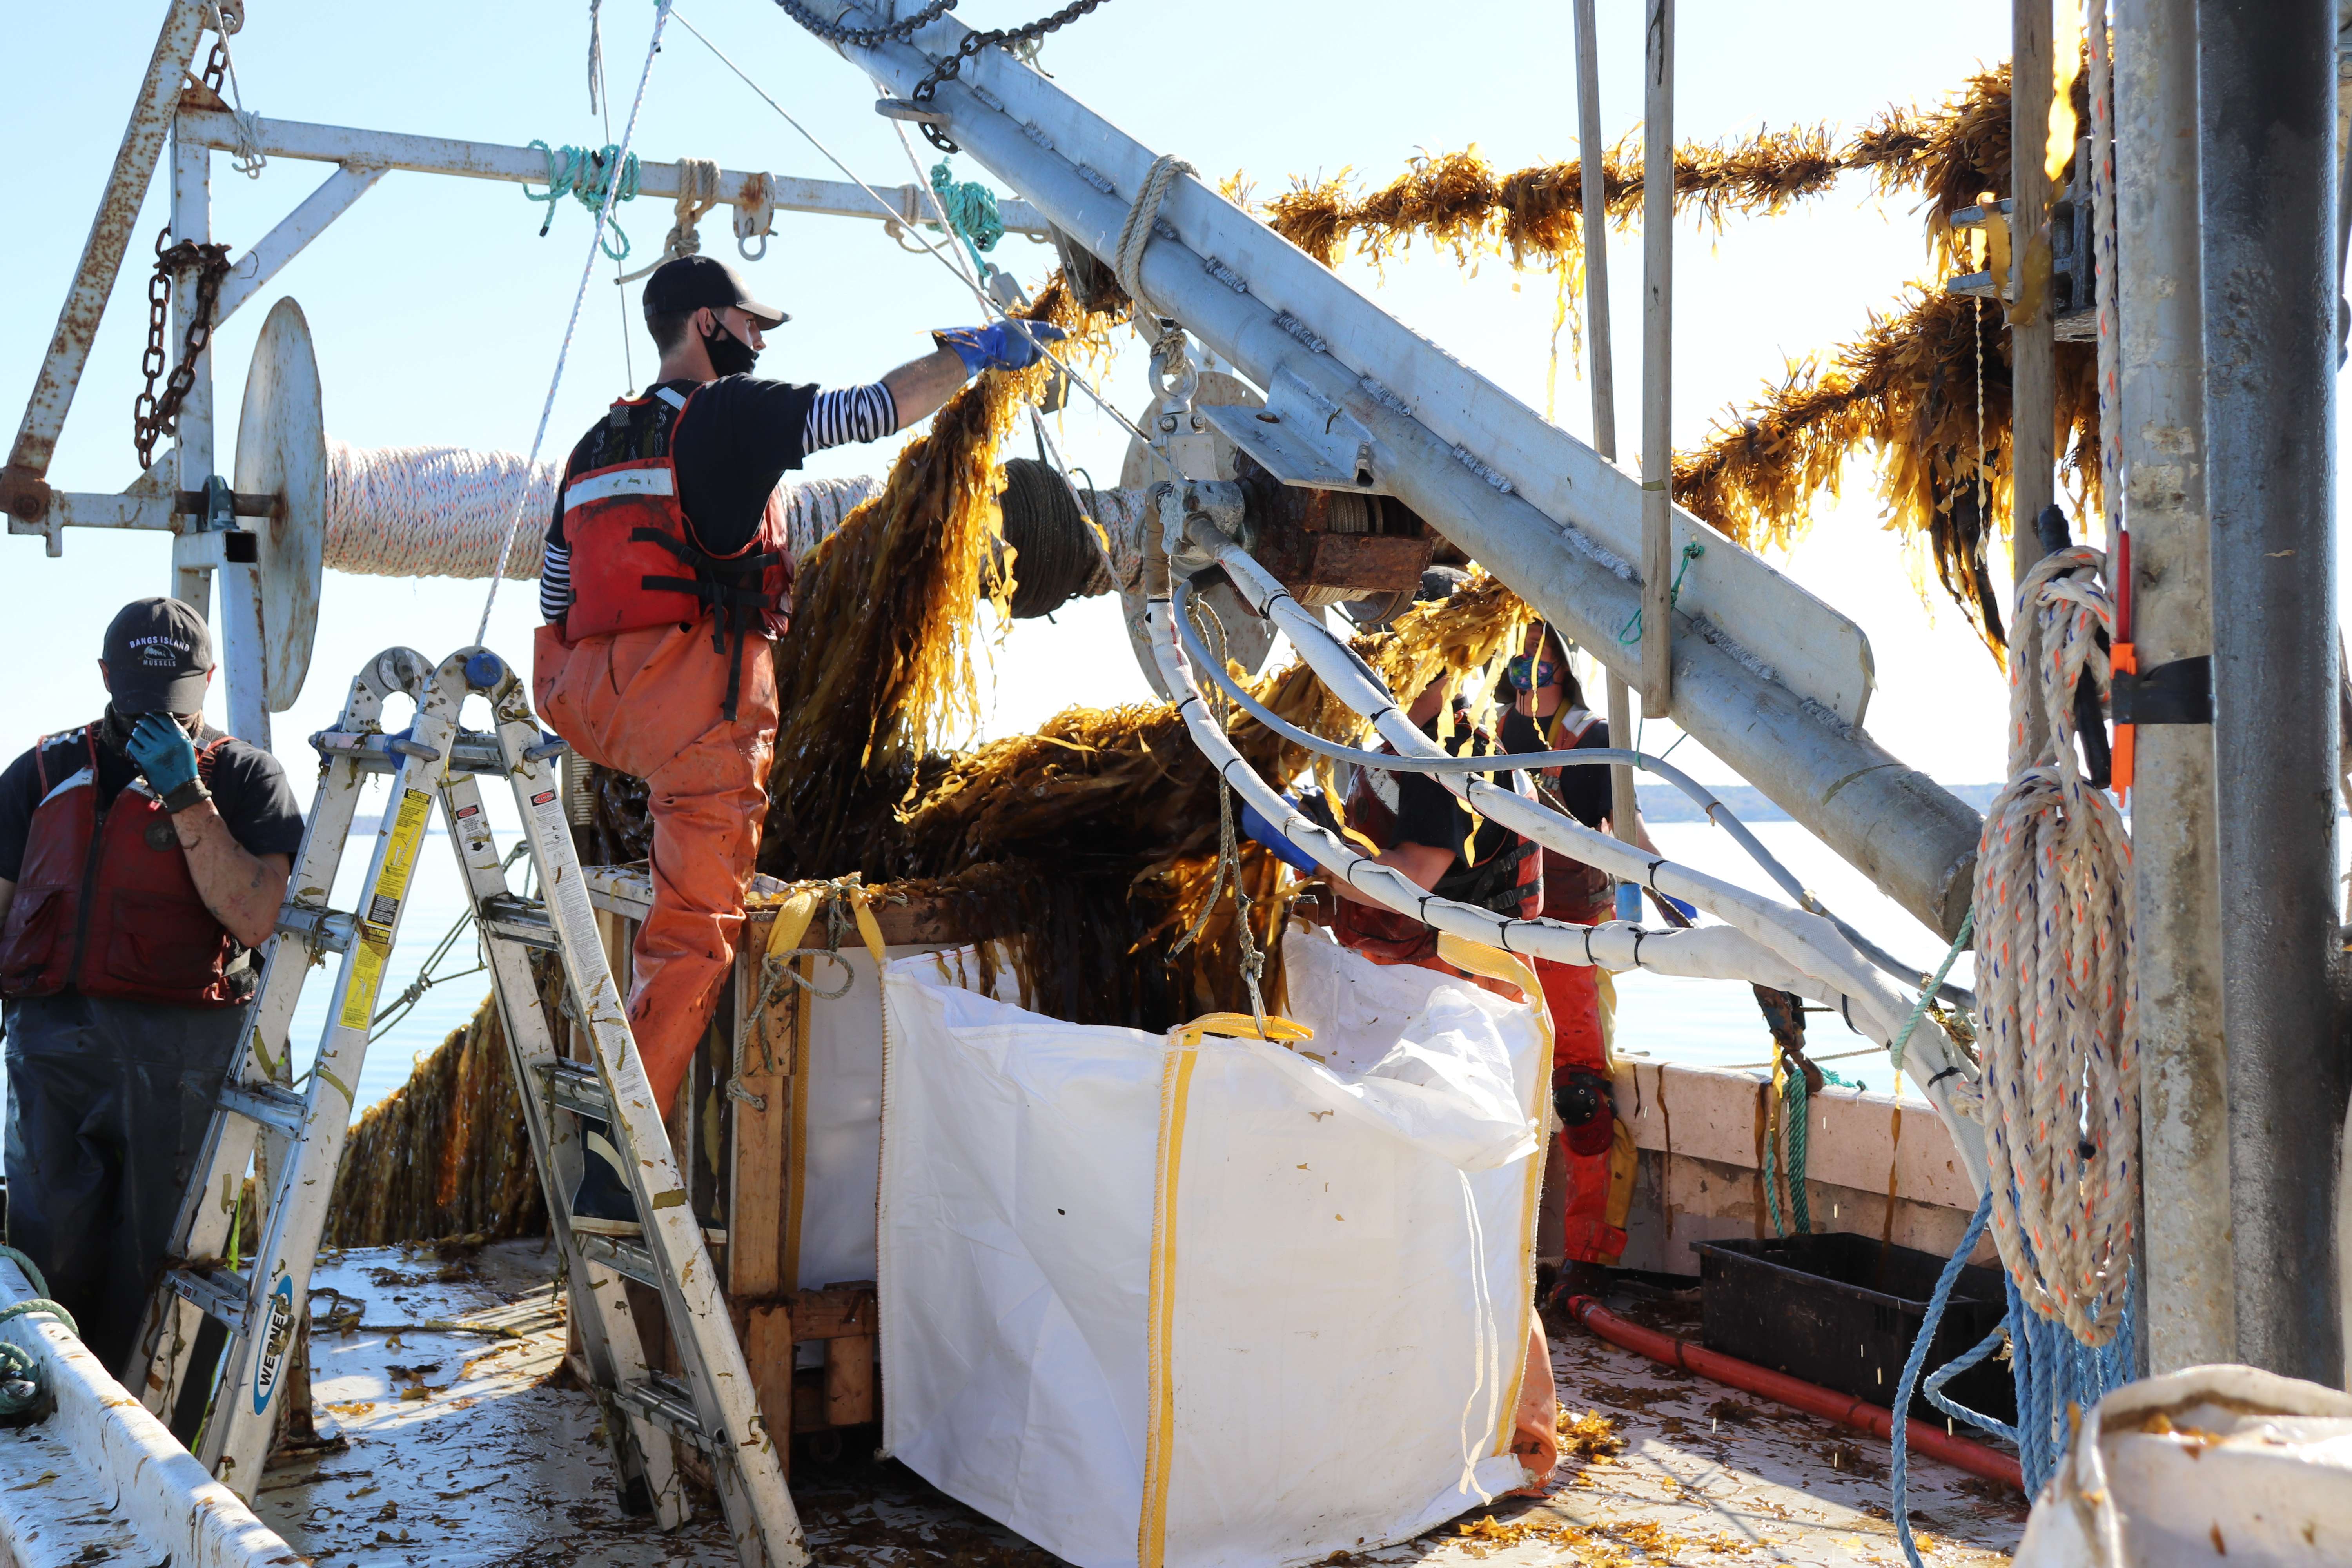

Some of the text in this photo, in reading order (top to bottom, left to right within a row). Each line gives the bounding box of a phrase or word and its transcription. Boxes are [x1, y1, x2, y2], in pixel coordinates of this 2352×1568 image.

[130, 636, 190, 652] BANGS ISLAND
[408, 789, 430, 800] CAUTION
[535, 793, 554, 802] PELIGRO
